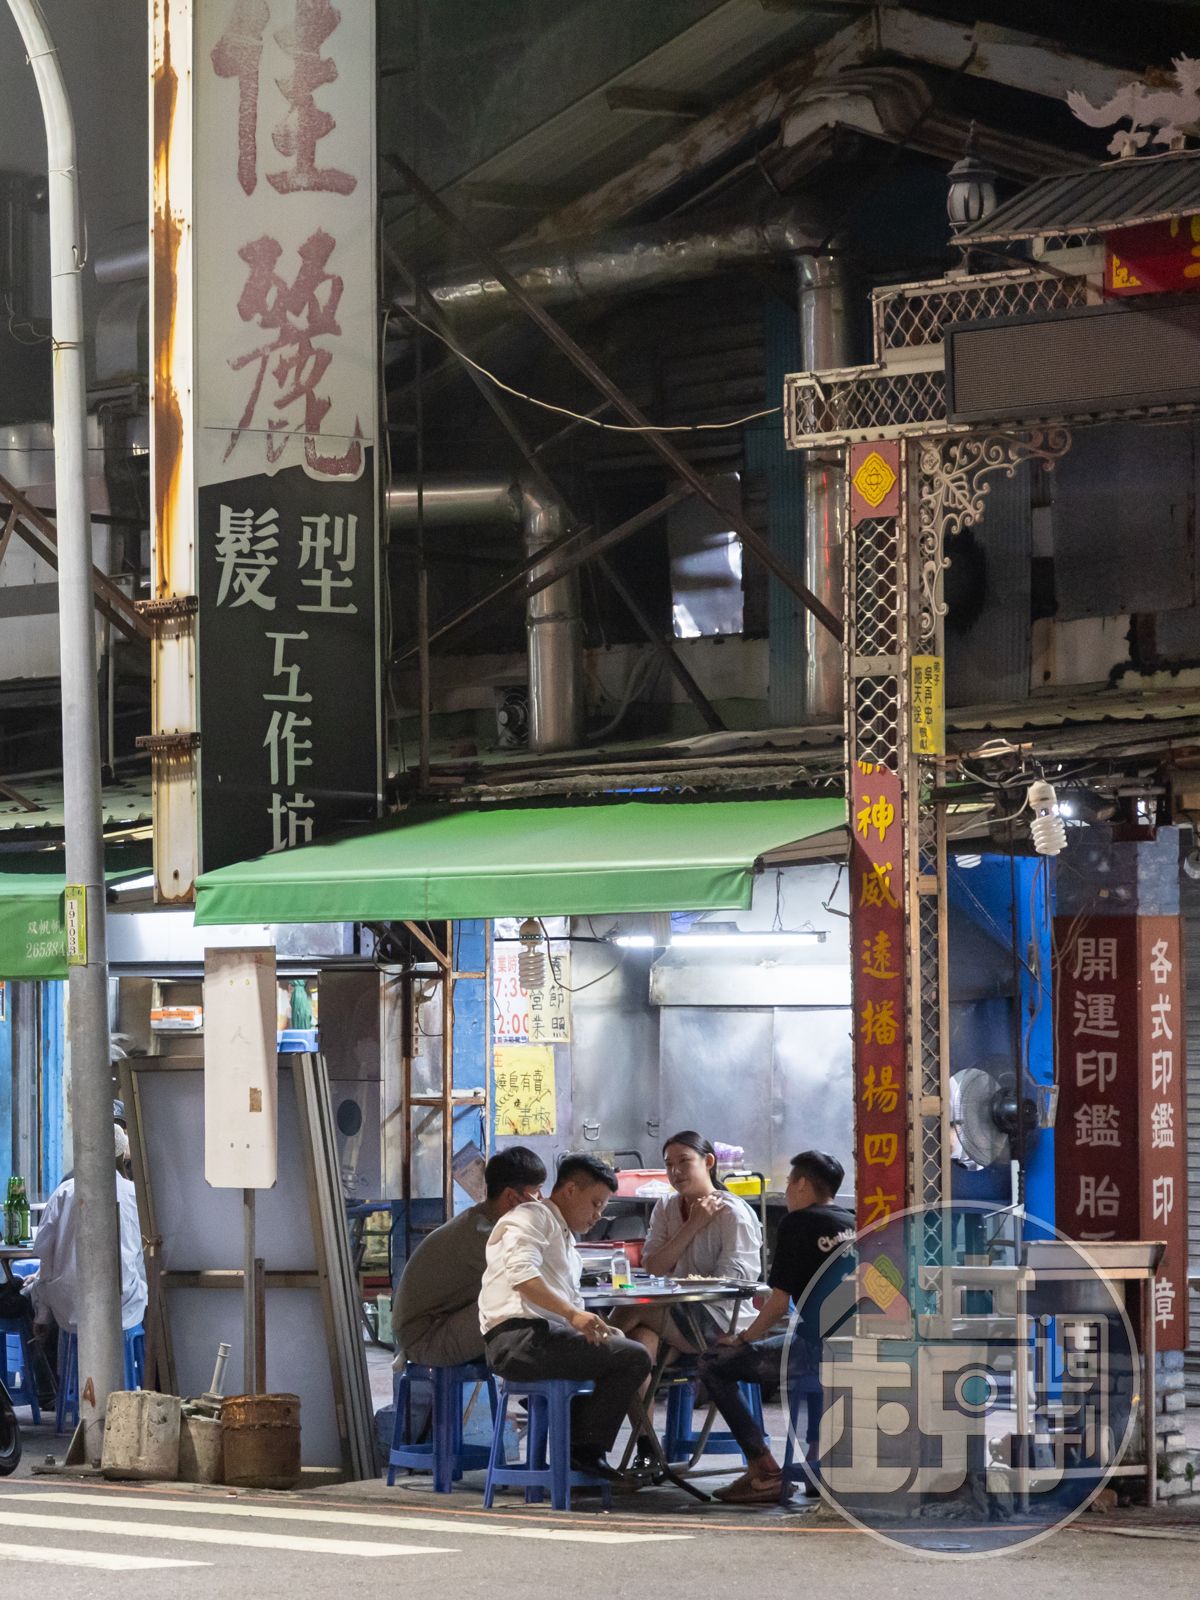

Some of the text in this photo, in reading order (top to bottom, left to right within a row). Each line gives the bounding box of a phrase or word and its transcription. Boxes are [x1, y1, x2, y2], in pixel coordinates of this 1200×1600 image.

[210, 0, 366, 478] 佳麗
[215, 503, 359, 615] 髮型
[263, 631, 314, 854] 工作坊
[1072, 937, 1121, 1148] 開運印鑑
[1149, 938, 1176, 1149] 各式印鑑
